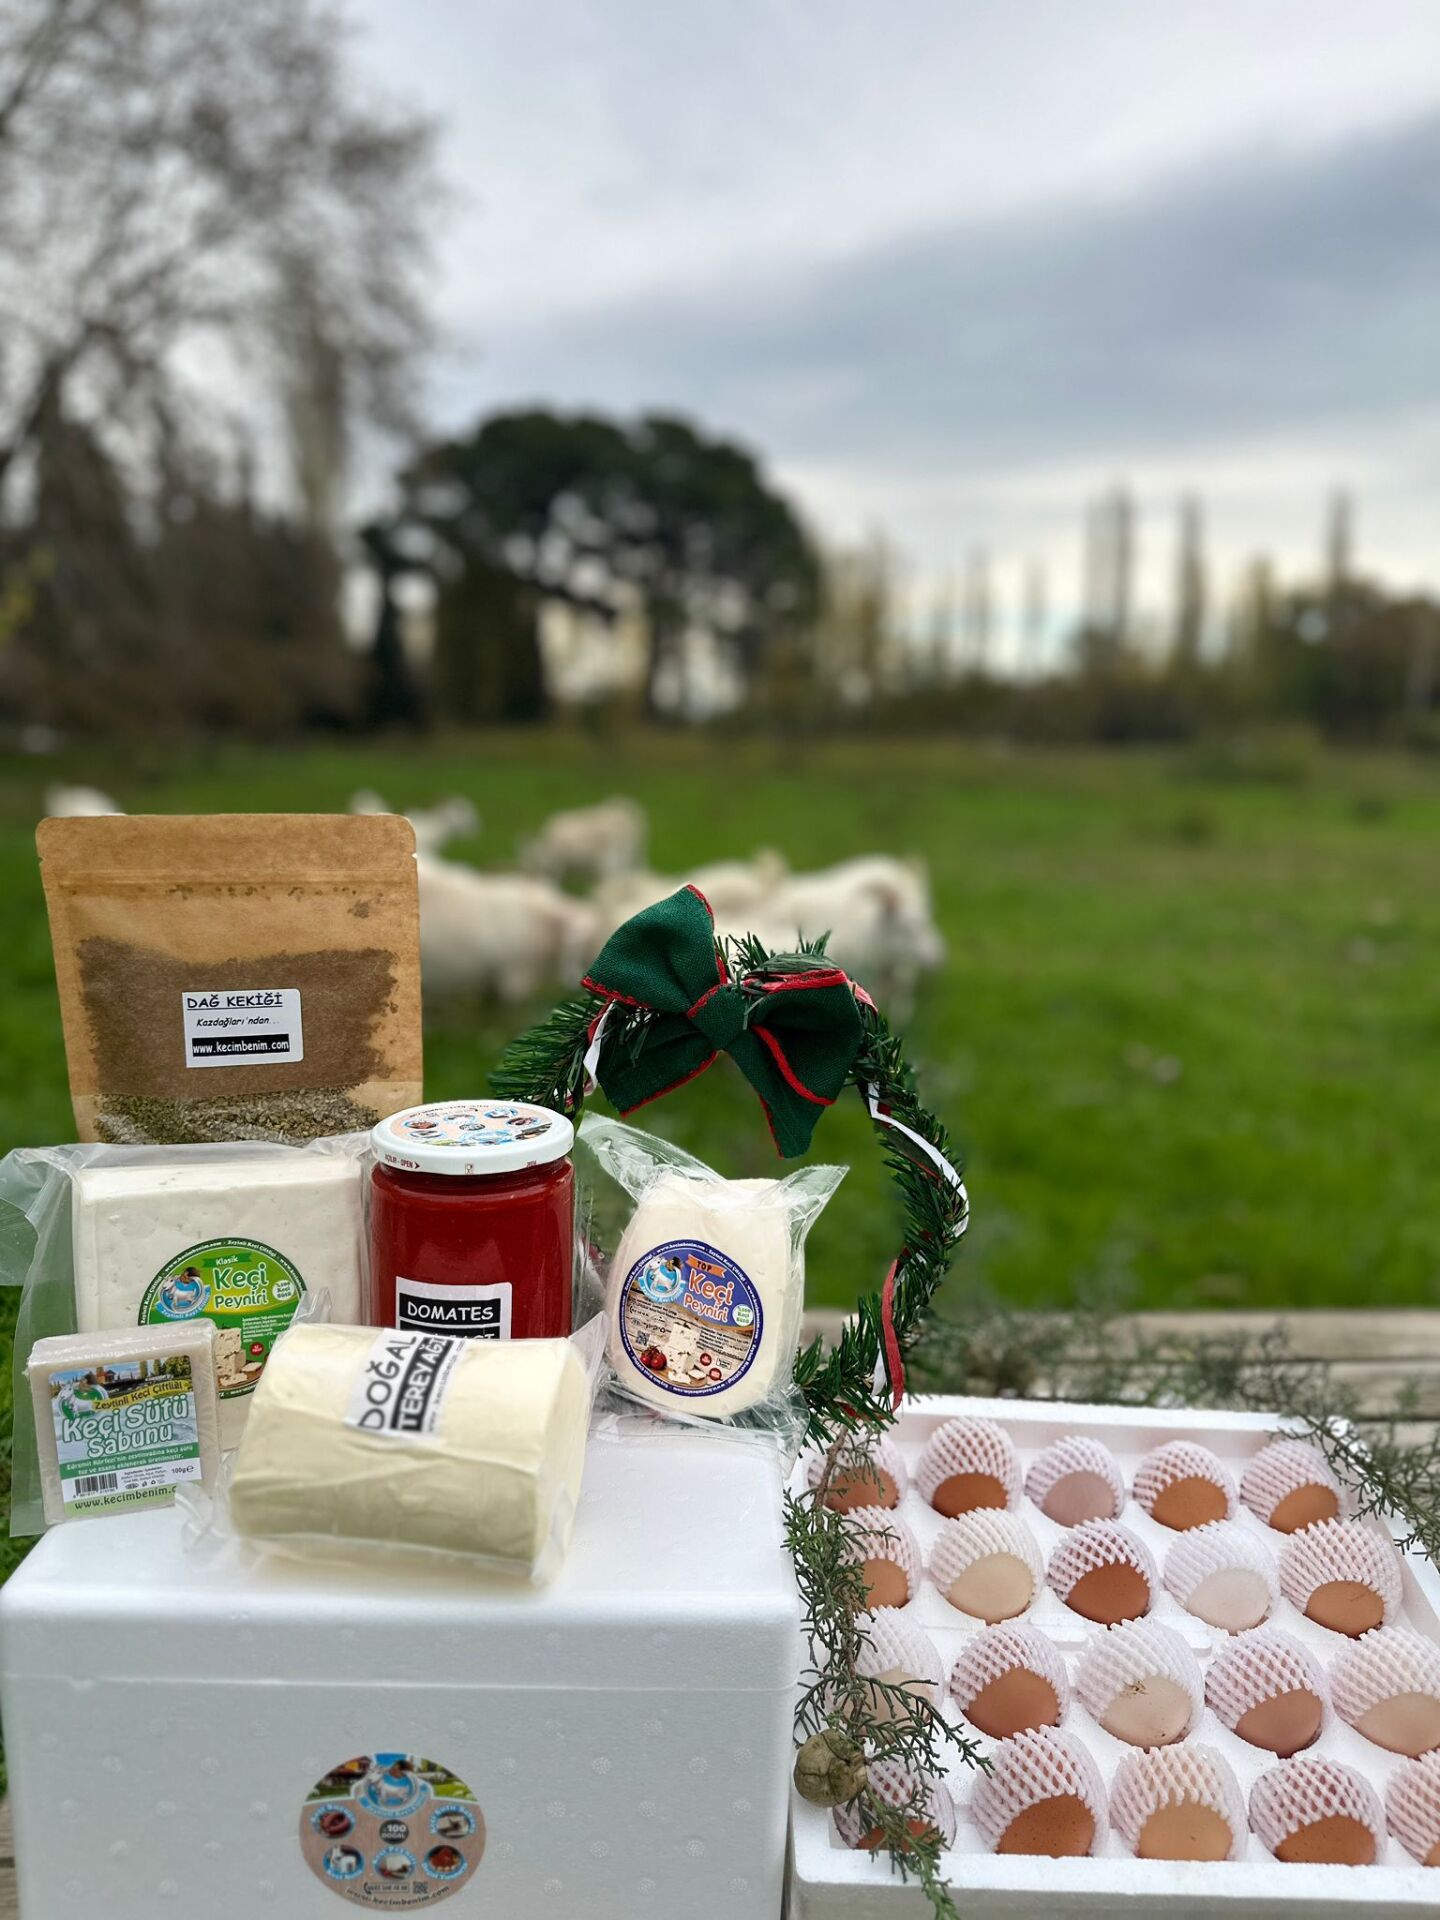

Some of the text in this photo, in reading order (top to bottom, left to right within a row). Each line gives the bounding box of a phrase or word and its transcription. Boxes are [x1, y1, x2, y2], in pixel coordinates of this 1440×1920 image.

[187, 992, 283, 1009] DAĞ KEKİĞİ
[192, 1040, 289, 1054] www.kecimbenim.com
[215, 1255, 239, 1266] Klasik
[696, 1261, 713, 1272] TOP
[214, 1262, 269, 1291] Keçi
[688, 1268, 735, 1306] Keçi
[214, 1290, 269, 1310] Peyniri
[407, 1301, 494, 1321] DOMATES
[683, 1293, 729, 1323] Peyniri
[357, 1336, 417, 1430] DOĞAL
[400, 1335, 449, 1430] TEREYAĞI
[94, 1396, 129, 1411] Zeytinli
[62, 1393, 189, 1443] Keçi Sütü
[87, 1424, 174, 1459] Sabunu
[75, 1485, 177, 1510] www.kecimbenim.c
